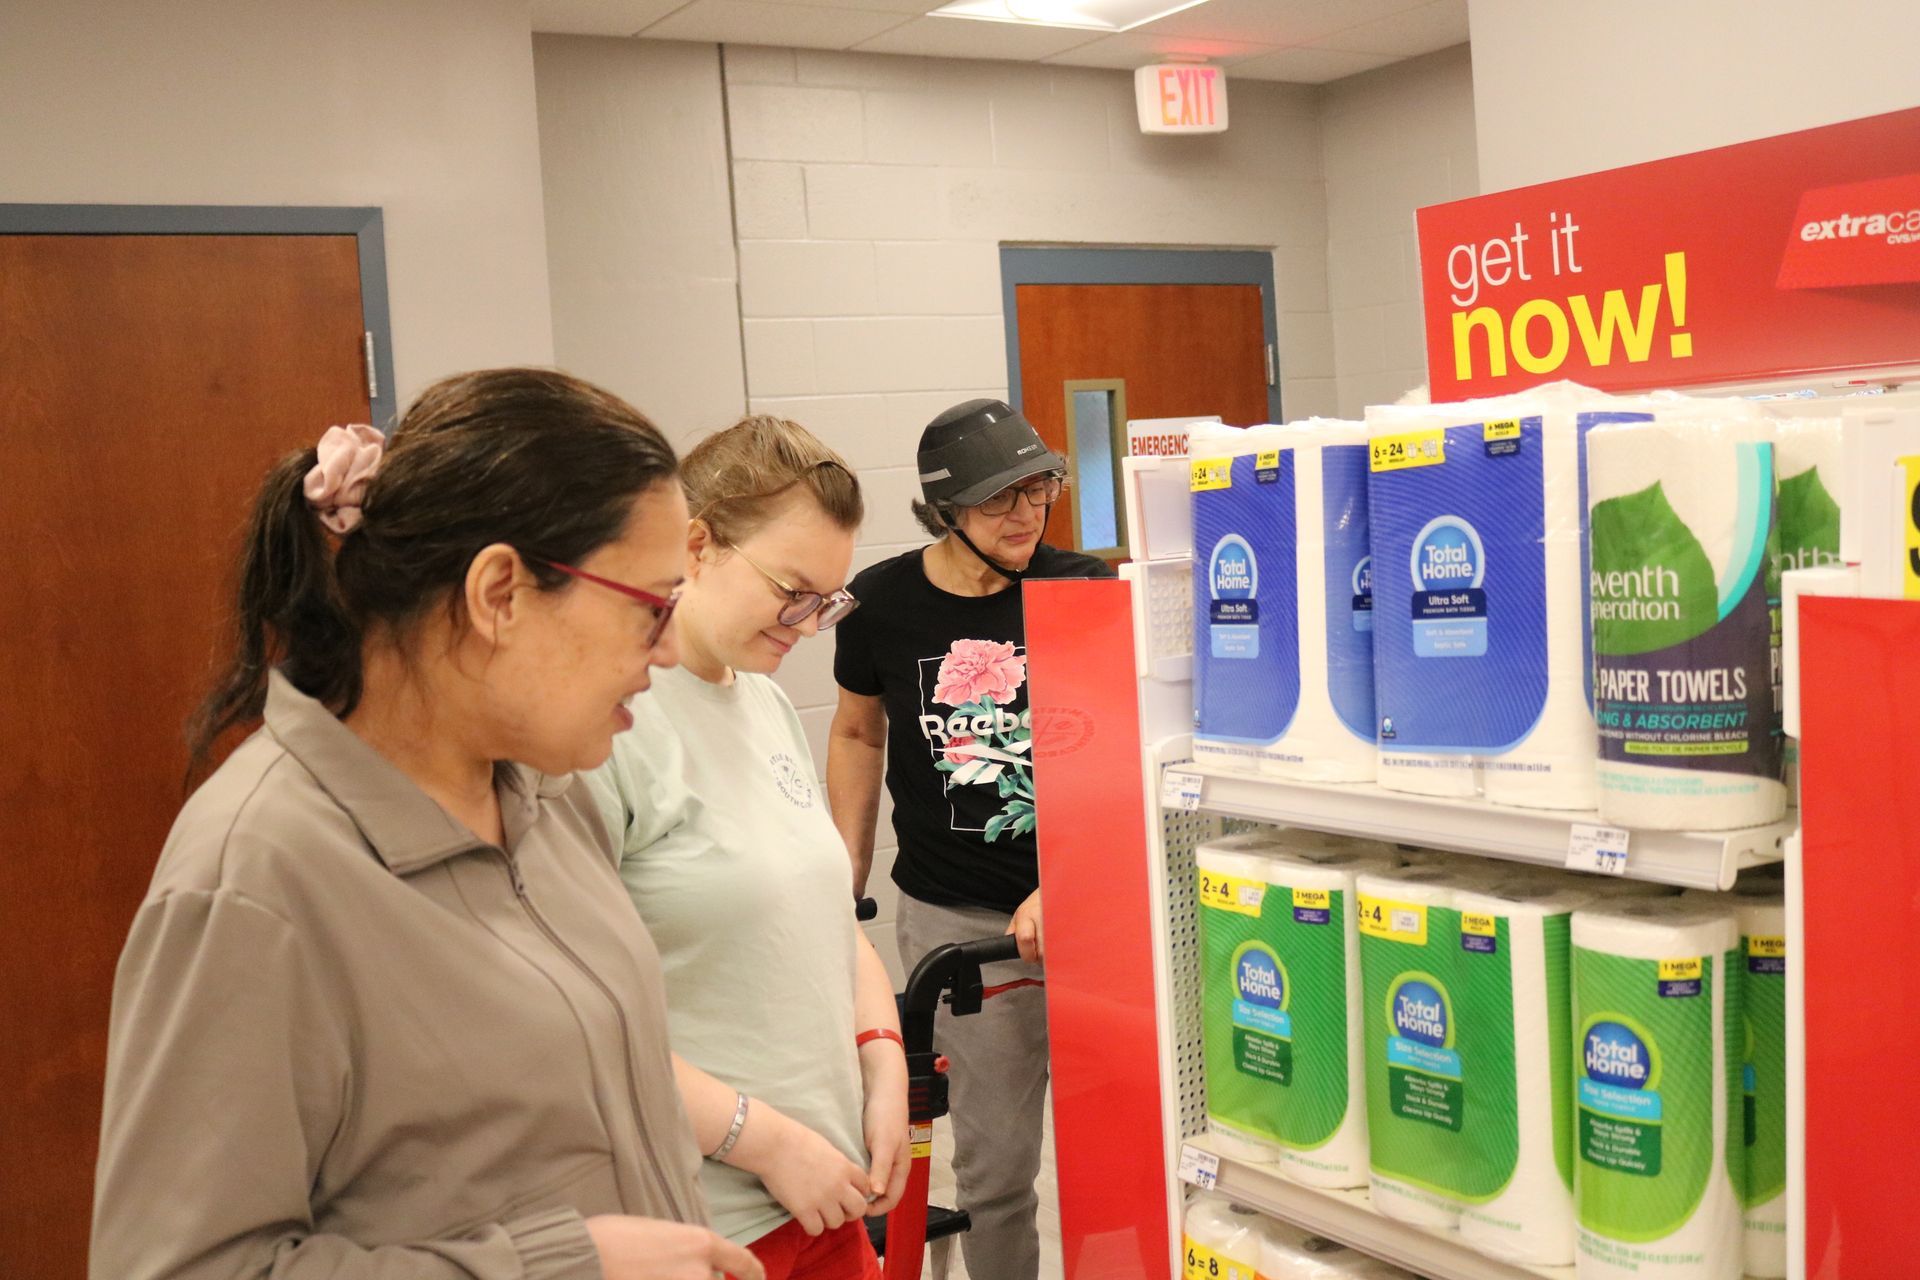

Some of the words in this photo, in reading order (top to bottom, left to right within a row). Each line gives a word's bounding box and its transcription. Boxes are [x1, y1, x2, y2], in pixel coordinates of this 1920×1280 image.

[1158, 67, 1216, 125] EXIT
[1800, 210, 1920, 242] extraca
[1447, 222, 1532, 307] get
[1550, 212, 1582, 276] it
[1452, 251, 1692, 381] now!
[1494, 421, 1515, 430] MEGA
[1131, 434, 1190, 456] EMERGENC
[1374, 446, 1380, 459] 6
[1389, 443, 1403, 456] 24
[1198, 468, 1206, 479] 24
[1425, 542, 1467, 564] Total
[1218, 558, 1246, 576] Total
[1592, 565, 1679, 598] eventh
[1221, 604, 1235, 613] Ultra
[1235, 604, 1248, 613] Soft
[1428, 596, 1449, 606] Ultra
[1451, 594, 1470, 605] Soft
[1600, 668, 1649, 703] PAPER
[1656, 667, 1747, 703] TOWELS
[918, 707, 1031, 745] Reeb
[1597, 711, 1619, 727] ONG
[1622, 713, 1631, 728] &
[1635, 712, 1748, 730] ABSORBENT
[1625, 732, 1662, 742] WITHOUT
[1664, 733, 1712, 742] CHLORINE
[1714, 731, 1748, 741] BLEACH
[1202, 877, 1209, 893] 2
[1220, 882, 1229, 898] 4
[1301, 892, 1325, 901] MEGA
[1373, 906, 1382, 923] 4
[1468, 917, 1490, 927] MEGA
[1242, 961, 1275, 985] Total
[1671, 962, 1698, 970] MEGA
[1400, 995, 1440, 1022] Total
[1414, 1046, 1452, 1063] Selection
[1589, 1035, 1637, 1062] Total
[1601, 1088, 1651, 1105] Selection
[1187, 1248, 1195, 1266] 6
[1198, 1260, 1205, 1269] =
[1209, 1257, 1219, 1277] 8
